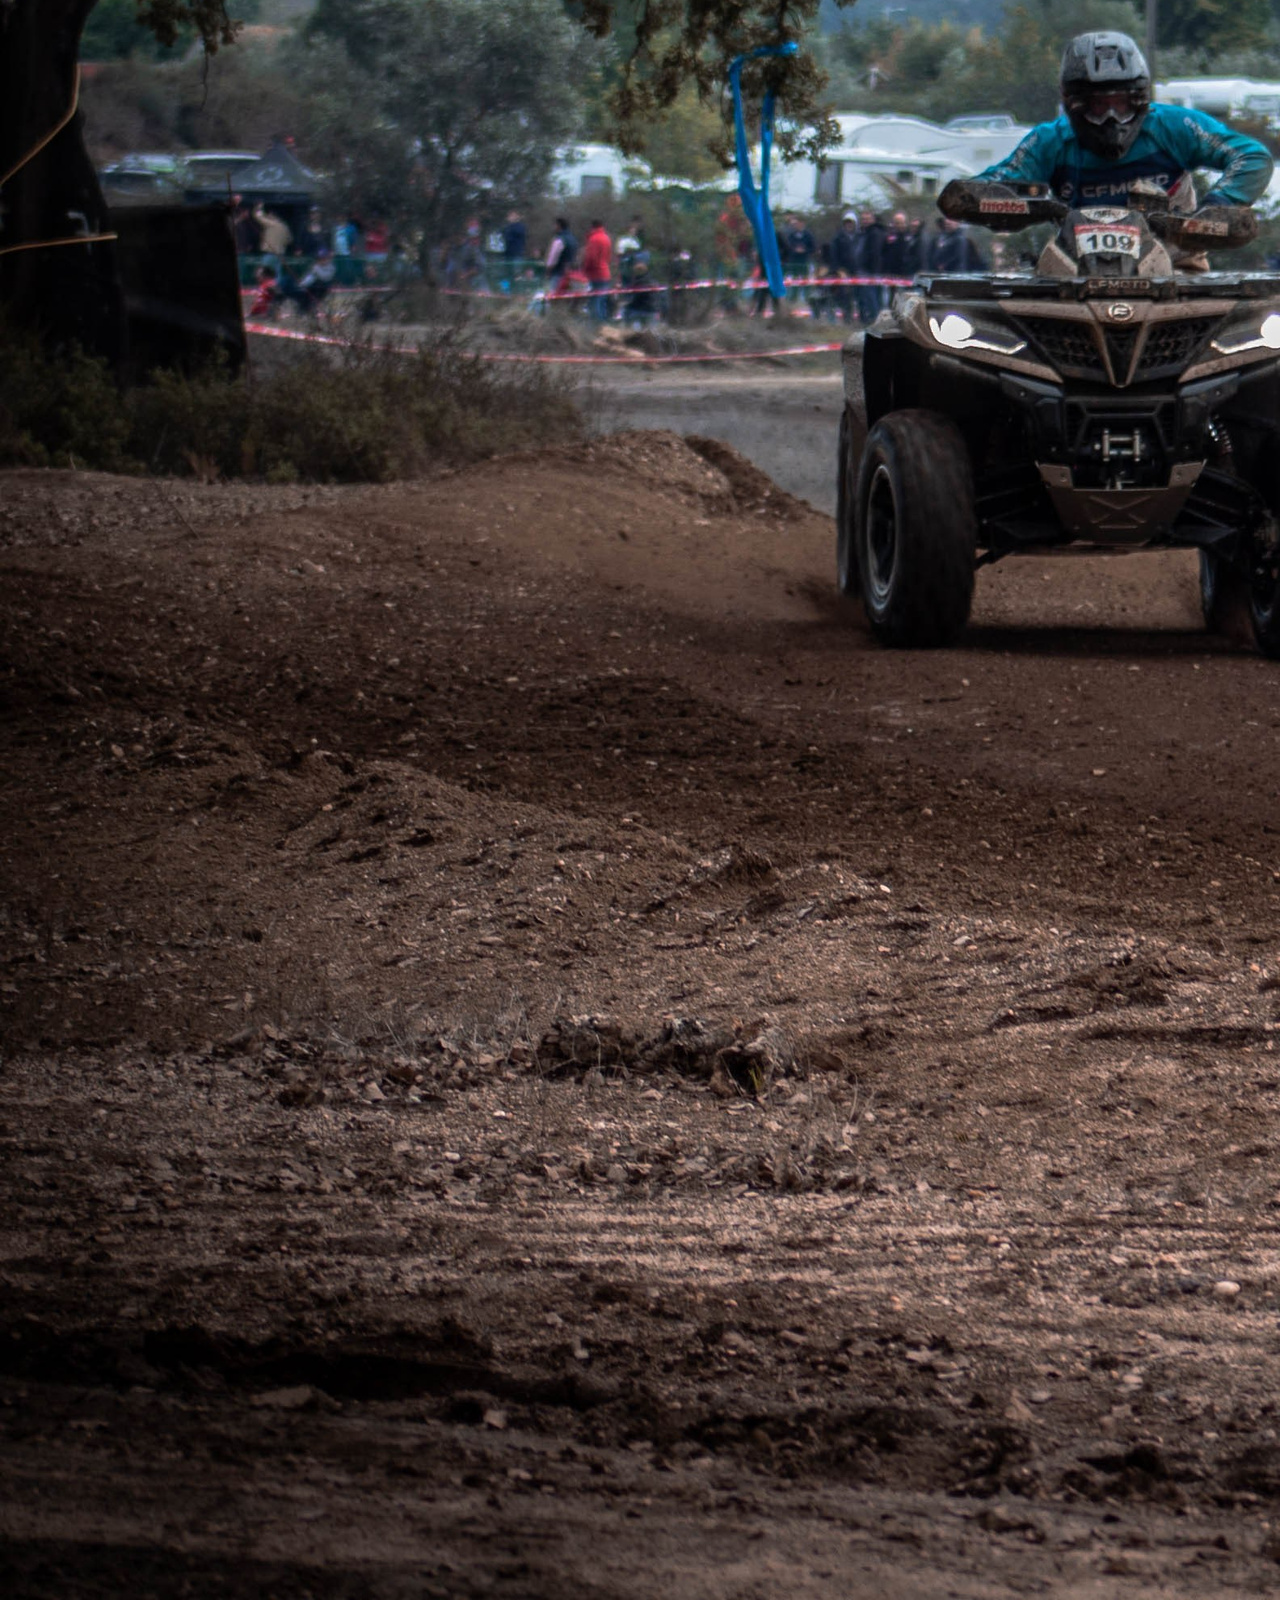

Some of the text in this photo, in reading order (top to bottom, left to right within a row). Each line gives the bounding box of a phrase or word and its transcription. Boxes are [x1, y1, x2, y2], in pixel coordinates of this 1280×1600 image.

[981, 201, 1026, 213] motos
[1087, 233, 1135, 251] 109
[1088, 280, 1151, 289] CFMOTO
